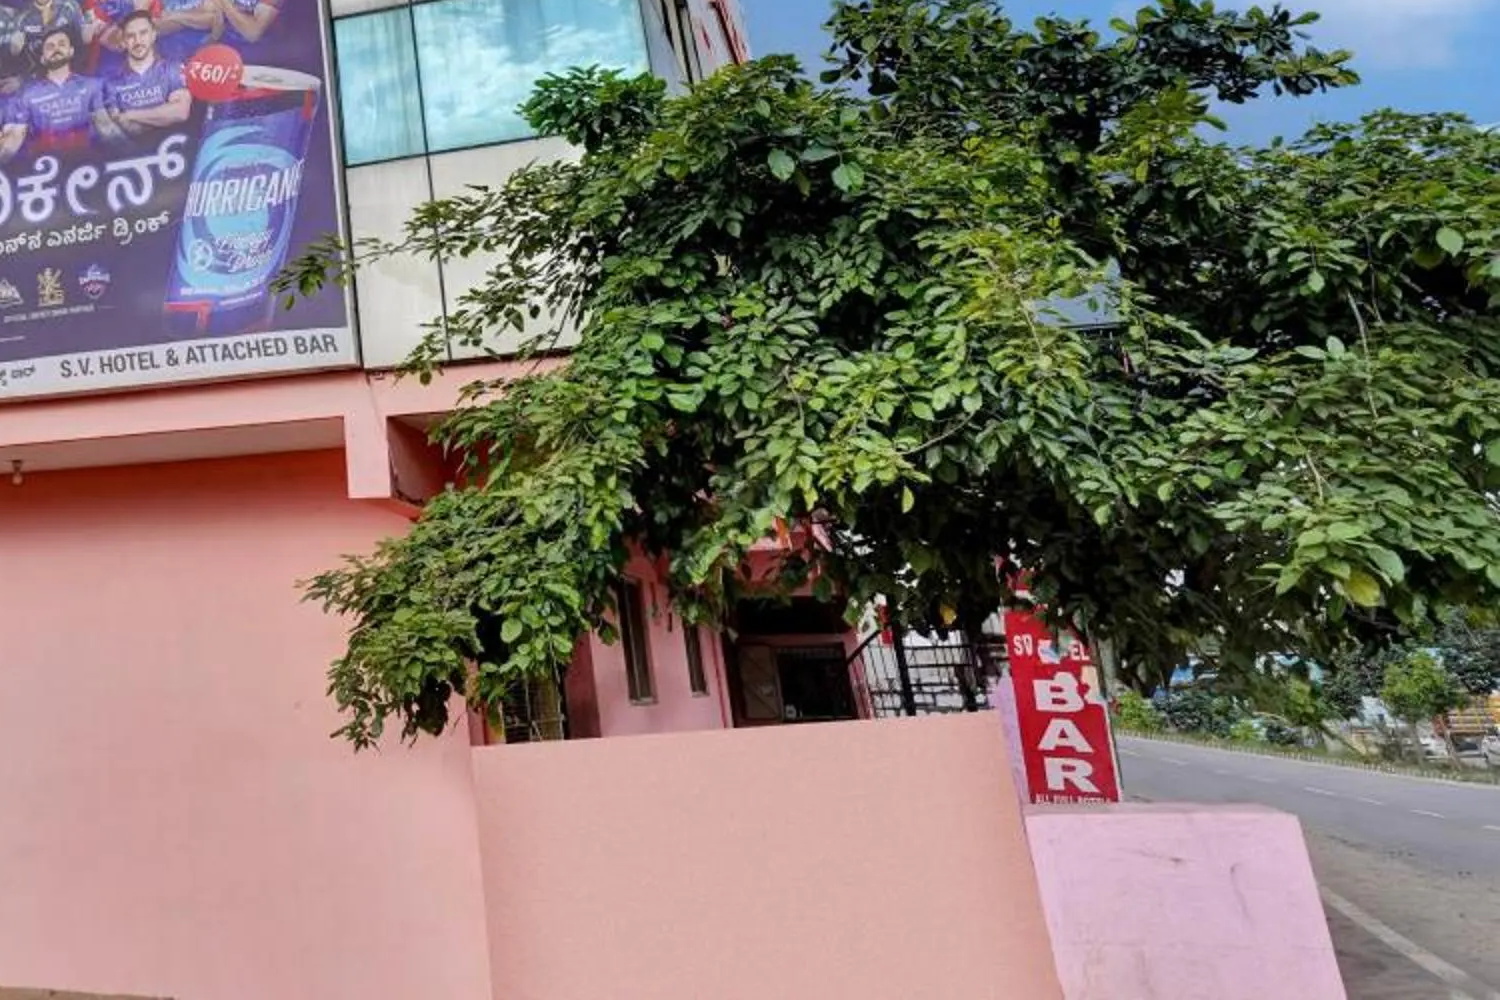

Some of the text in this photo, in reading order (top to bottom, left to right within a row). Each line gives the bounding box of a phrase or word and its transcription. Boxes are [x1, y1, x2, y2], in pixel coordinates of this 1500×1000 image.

[60, 333, 339, 378] S.V. HOTEL & ATTACHED BAR
[1032, 671, 1102, 794] BAR
